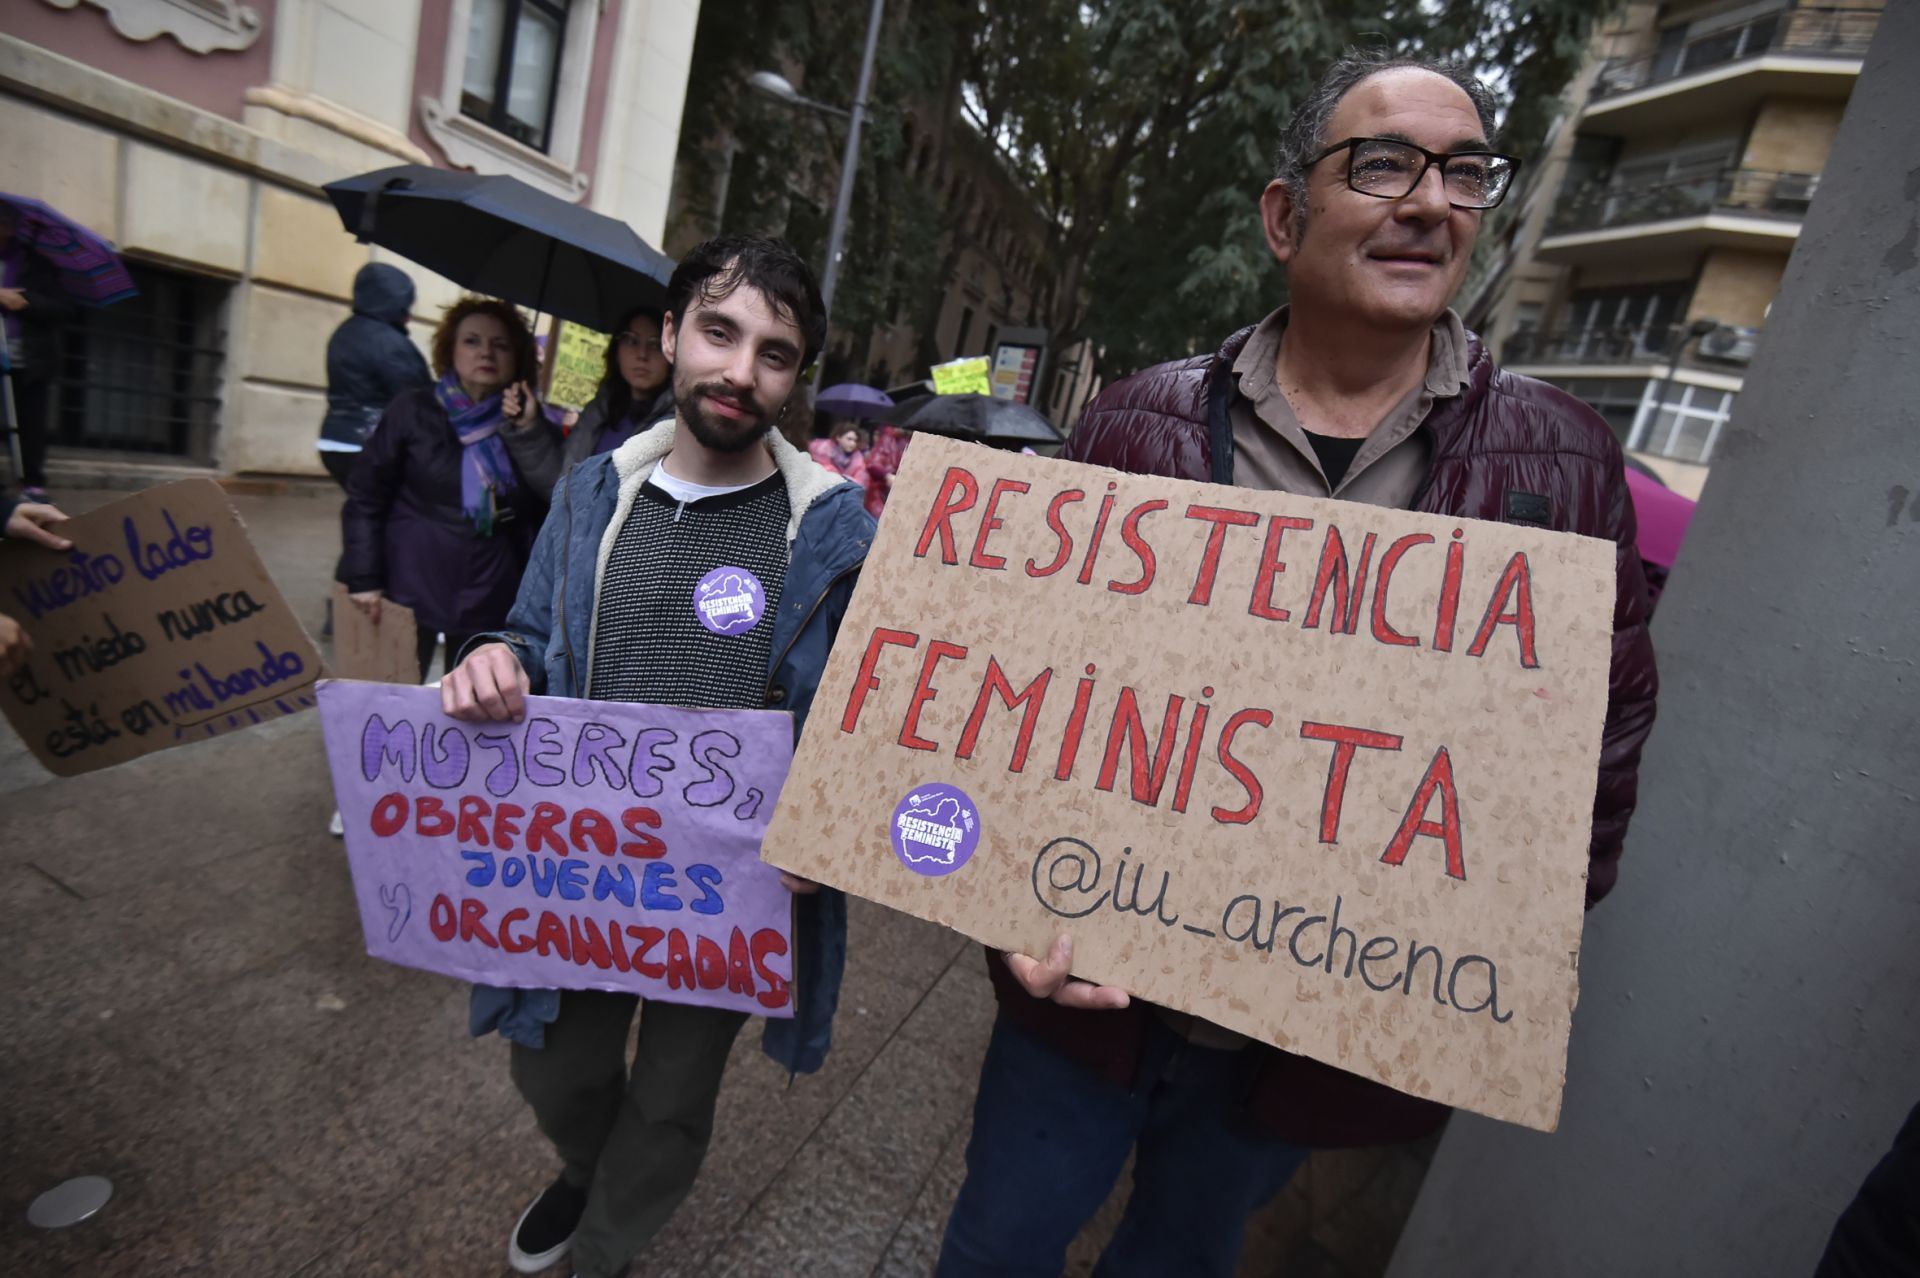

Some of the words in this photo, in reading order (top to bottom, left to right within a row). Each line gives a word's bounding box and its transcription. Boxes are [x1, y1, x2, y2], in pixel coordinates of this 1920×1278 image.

[124, 508, 213, 580] lado
[913, 466, 1539, 668] RESISTENCIA
[54, 613, 146, 681] miedo
[158, 590, 265, 641] nunca
[46, 698, 120, 757] está
[122, 700, 169, 735] en
[361, 714, 763, 820] MUJERES,
[841, 627, 1466, 880] FEMINISTA
[370, 792, 667, 859] OBRERAS
[897, 813, 963, 844] RESISTENCIA
[901, 827, 955, 851] FEMINISTA
[461, 850, 724, 915] JOVENES
[429, 894, 789, 1008] ORGANIZADAS
[1032, 836, 1513, 1023] @iu_archena
